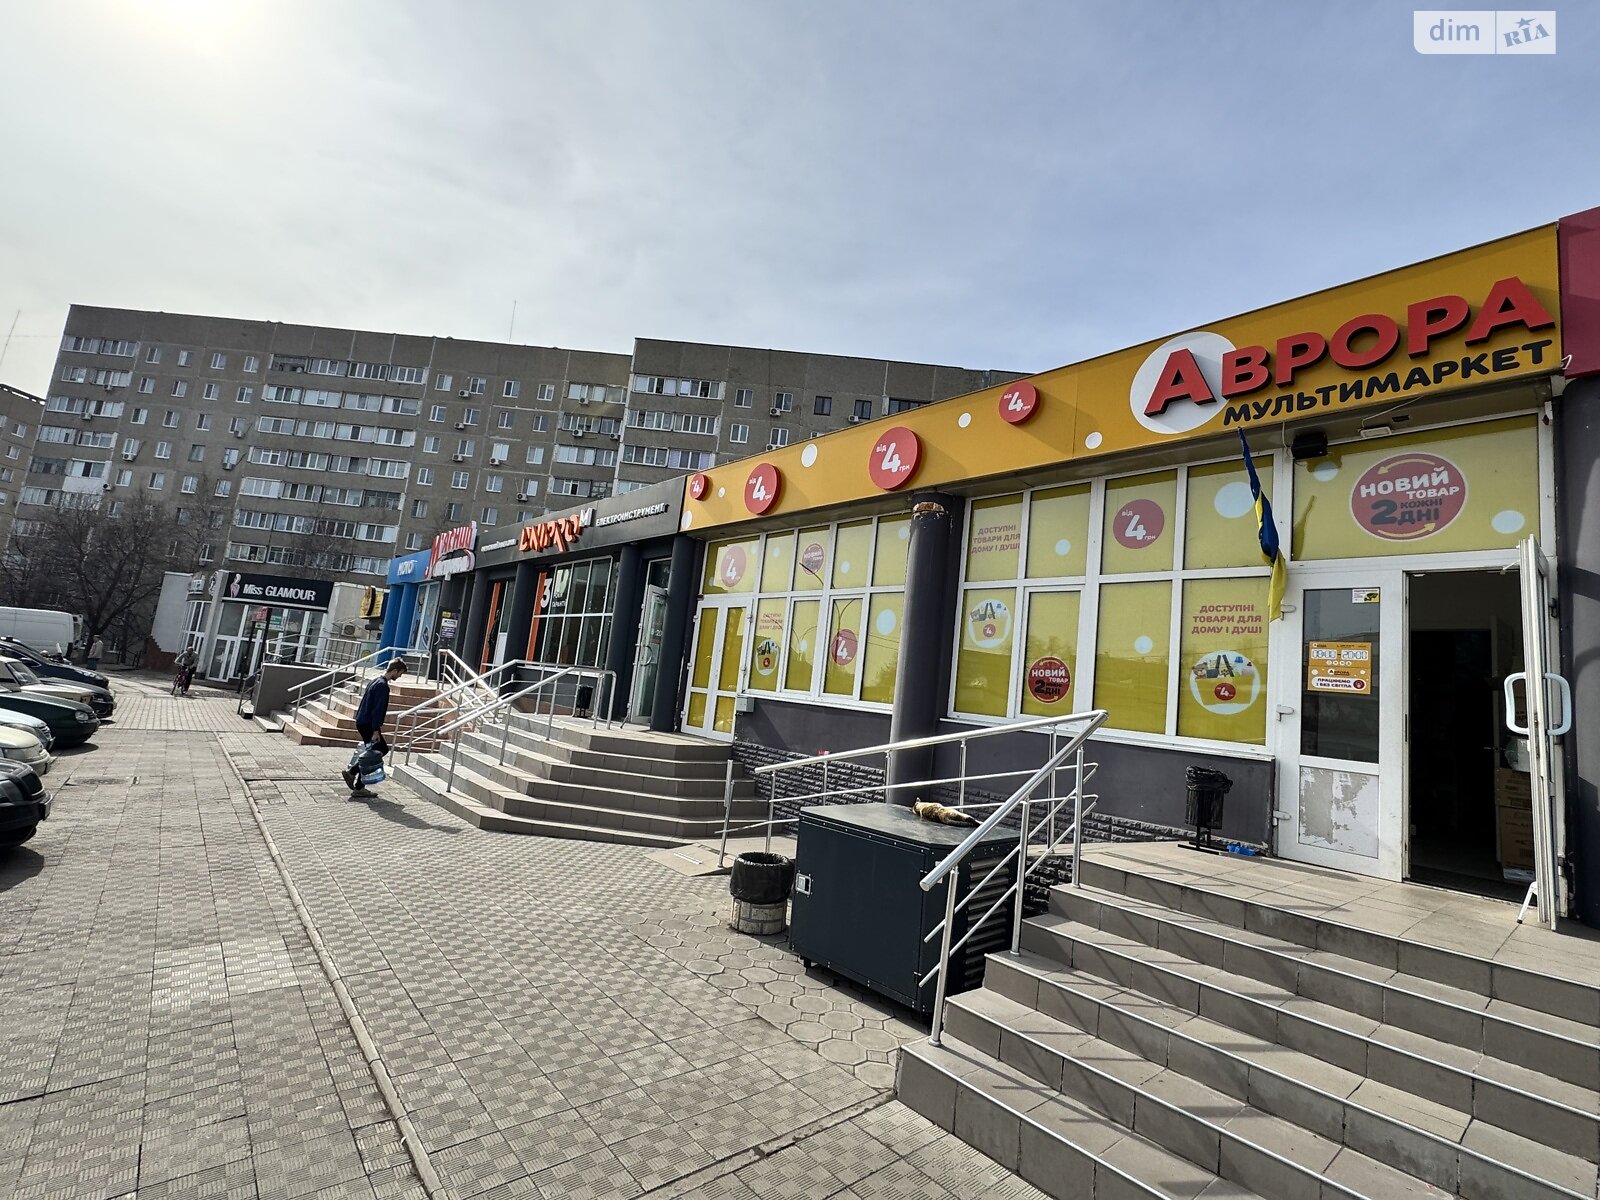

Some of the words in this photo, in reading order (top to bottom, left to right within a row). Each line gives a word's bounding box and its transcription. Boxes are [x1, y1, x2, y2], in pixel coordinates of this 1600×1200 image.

[1144, 276, 1556, 416] АВРОРА
[1223, 339, 1553, 426] МУЛЬТИМАРКЕТ
[1008, 391, 1023, 412] 4
[876, 443, 887, 453] від
[881, 442, 901, 473] 4
[898, 464, 910, 473] грн
[693, 480, 700, 493] 4
[752, 476, 766, 501] 4
[1360, 466, 1449, 498] НОВИЙ
[1406, 486, 1460, 500] ТОВАР
[1400, 498, 1443, 509] КОЖНІ
[1121, 509, 1133, 518] від
[1370, 499, 1398, 525] 2
[1397, 508, 1440, 525] ДНІ
[978, 524, 1016, 535] ДОСТУПНІ
[1124, 514, 1147, 541] 4
[973, 534, 1002, 545] ТОВАРИ
[1003, 533, 1021, 542] ДЛЯ
[971, 544, 994, 554] ДОМУ
[998, 543, 1020, 552] ДУШІ
[726, 558, 737, 580] 4
[265, 585, 317, 601] GLAMOUR
[540, 577, 553, 608] 3
[1199, 604, 1255, 613] ДОСТУПНІ
[1192, 615, 1235, 623] ТОВАРИ
[1237, 615, 1262, 624] ДЛЯ
[1191, 626, 1223, 634] ДОМУ
[1231, 626, 1262, 634] ДУШІ
[837, 639, 848, 660] 4
[1031, 666, 1066, 677] НОВИЙ
[1034, 679, 1046, 694] 2
[1045, 687, 1060, 695] ДНІ
[1220, 687, 1230, 697] 4
